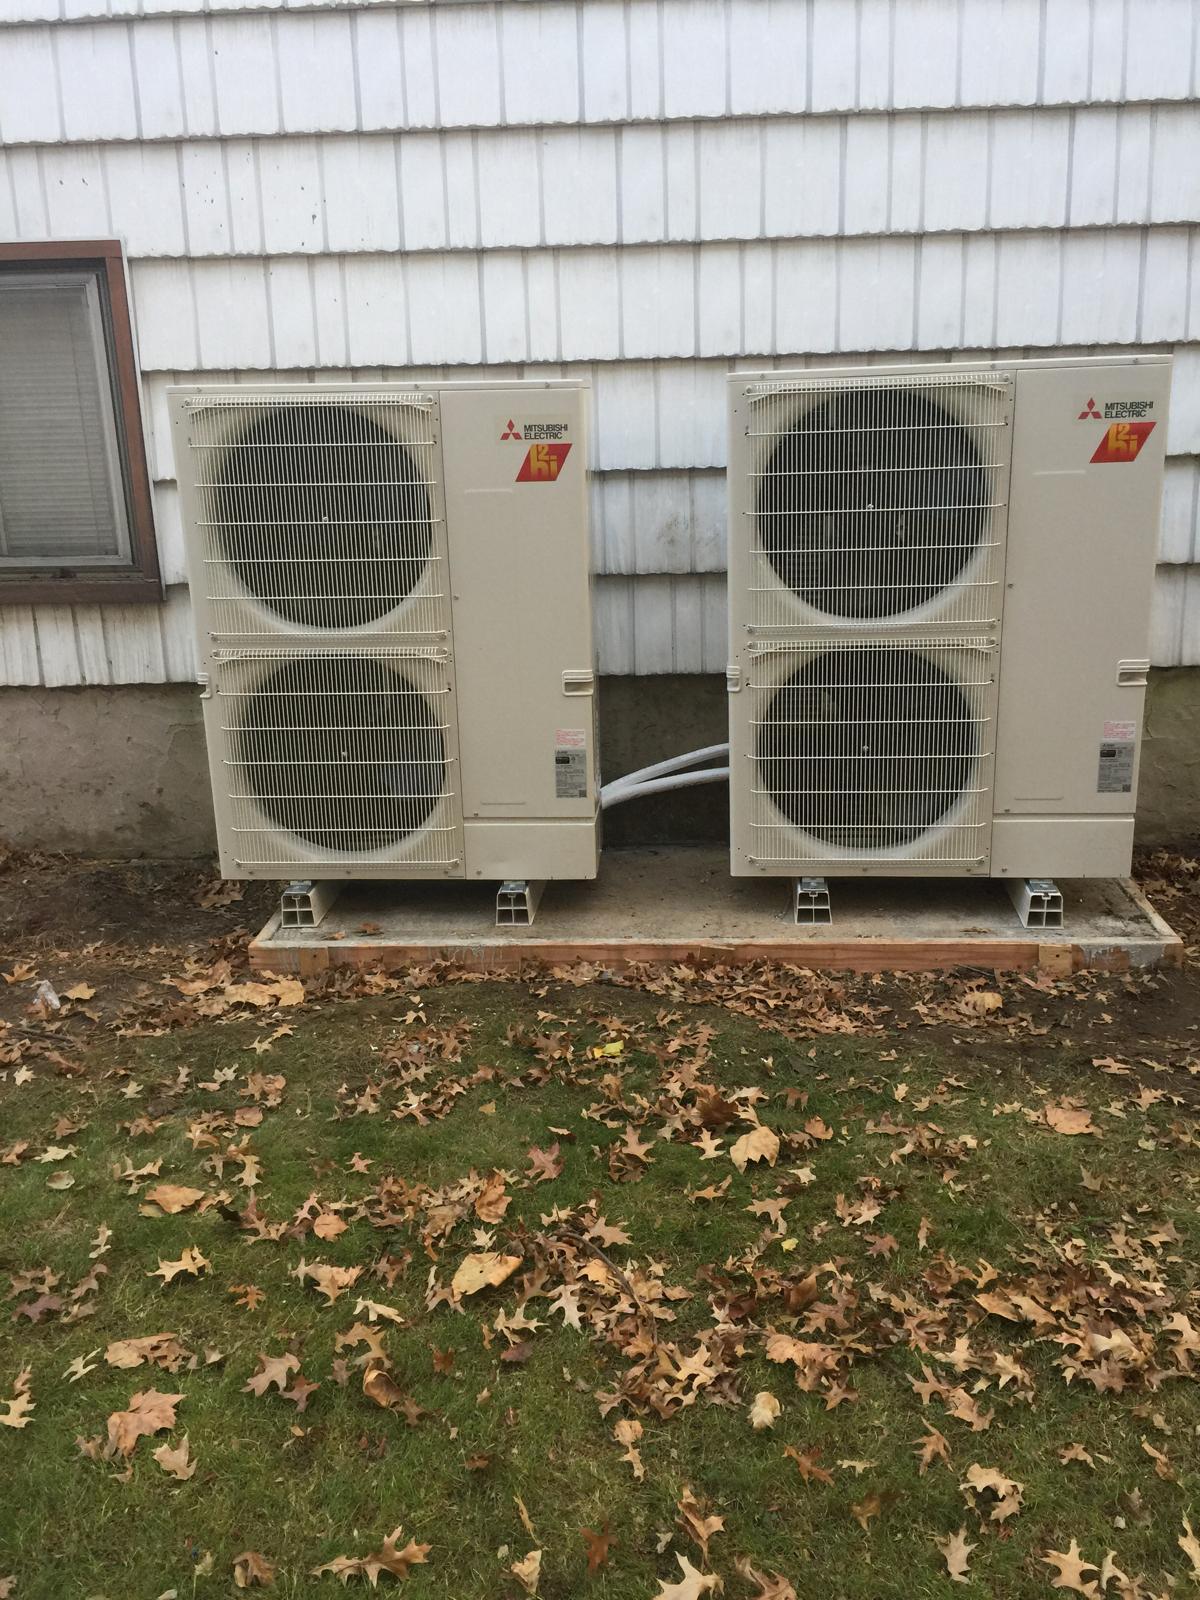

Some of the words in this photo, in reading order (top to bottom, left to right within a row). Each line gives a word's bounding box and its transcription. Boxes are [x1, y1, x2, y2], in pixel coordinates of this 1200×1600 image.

[1105, 401, 1154, 410] MITSUBISHI
[1104, 409, 1147, 418] ELECTRIC
[524, 424, 568, 432] MITSUBISHI
[524, 432, 563, 440] ELECTRIC
